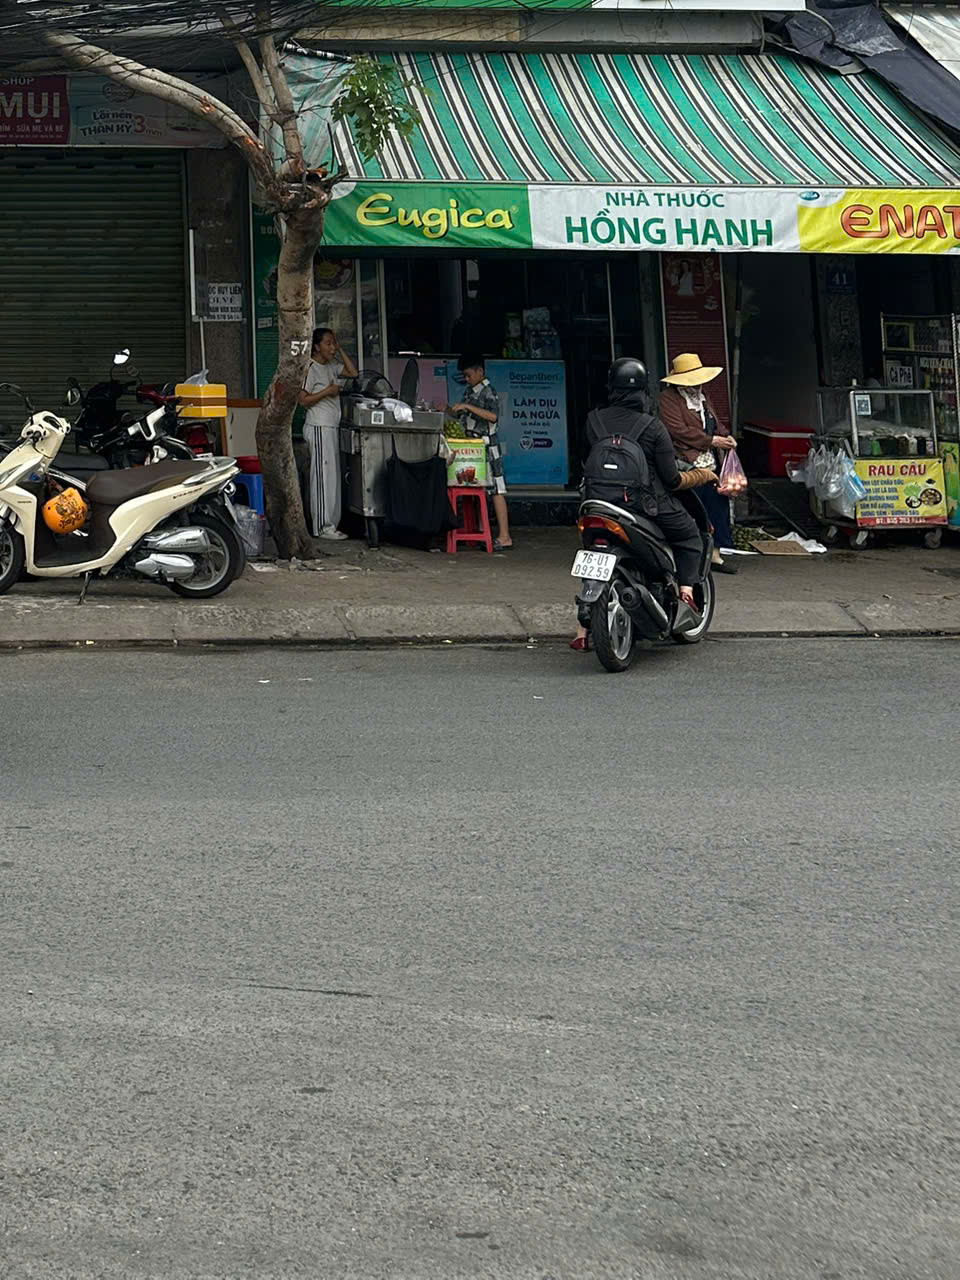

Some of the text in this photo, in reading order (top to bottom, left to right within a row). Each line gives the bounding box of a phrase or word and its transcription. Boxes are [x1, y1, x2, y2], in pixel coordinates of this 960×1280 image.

[606, 189, 725, 208] NHÀ THUỐC
[355, 193, 515, 239] Eugica
[840, 204, 960, 239] ENAT
[565, 208, 773, 252] HỒNG HẠNH
[832, 272, 848, 285] 41
[290, 340, 309, 356] 57
[509, 371, 559, 382] Bepanthen
[514, 396, 557, 410] LÀM DỊU
[512, 411, 527, 419] DA
[868, 461, 927, 476] RAU CÂU
[582, 552, 609, 567] 76-U1
